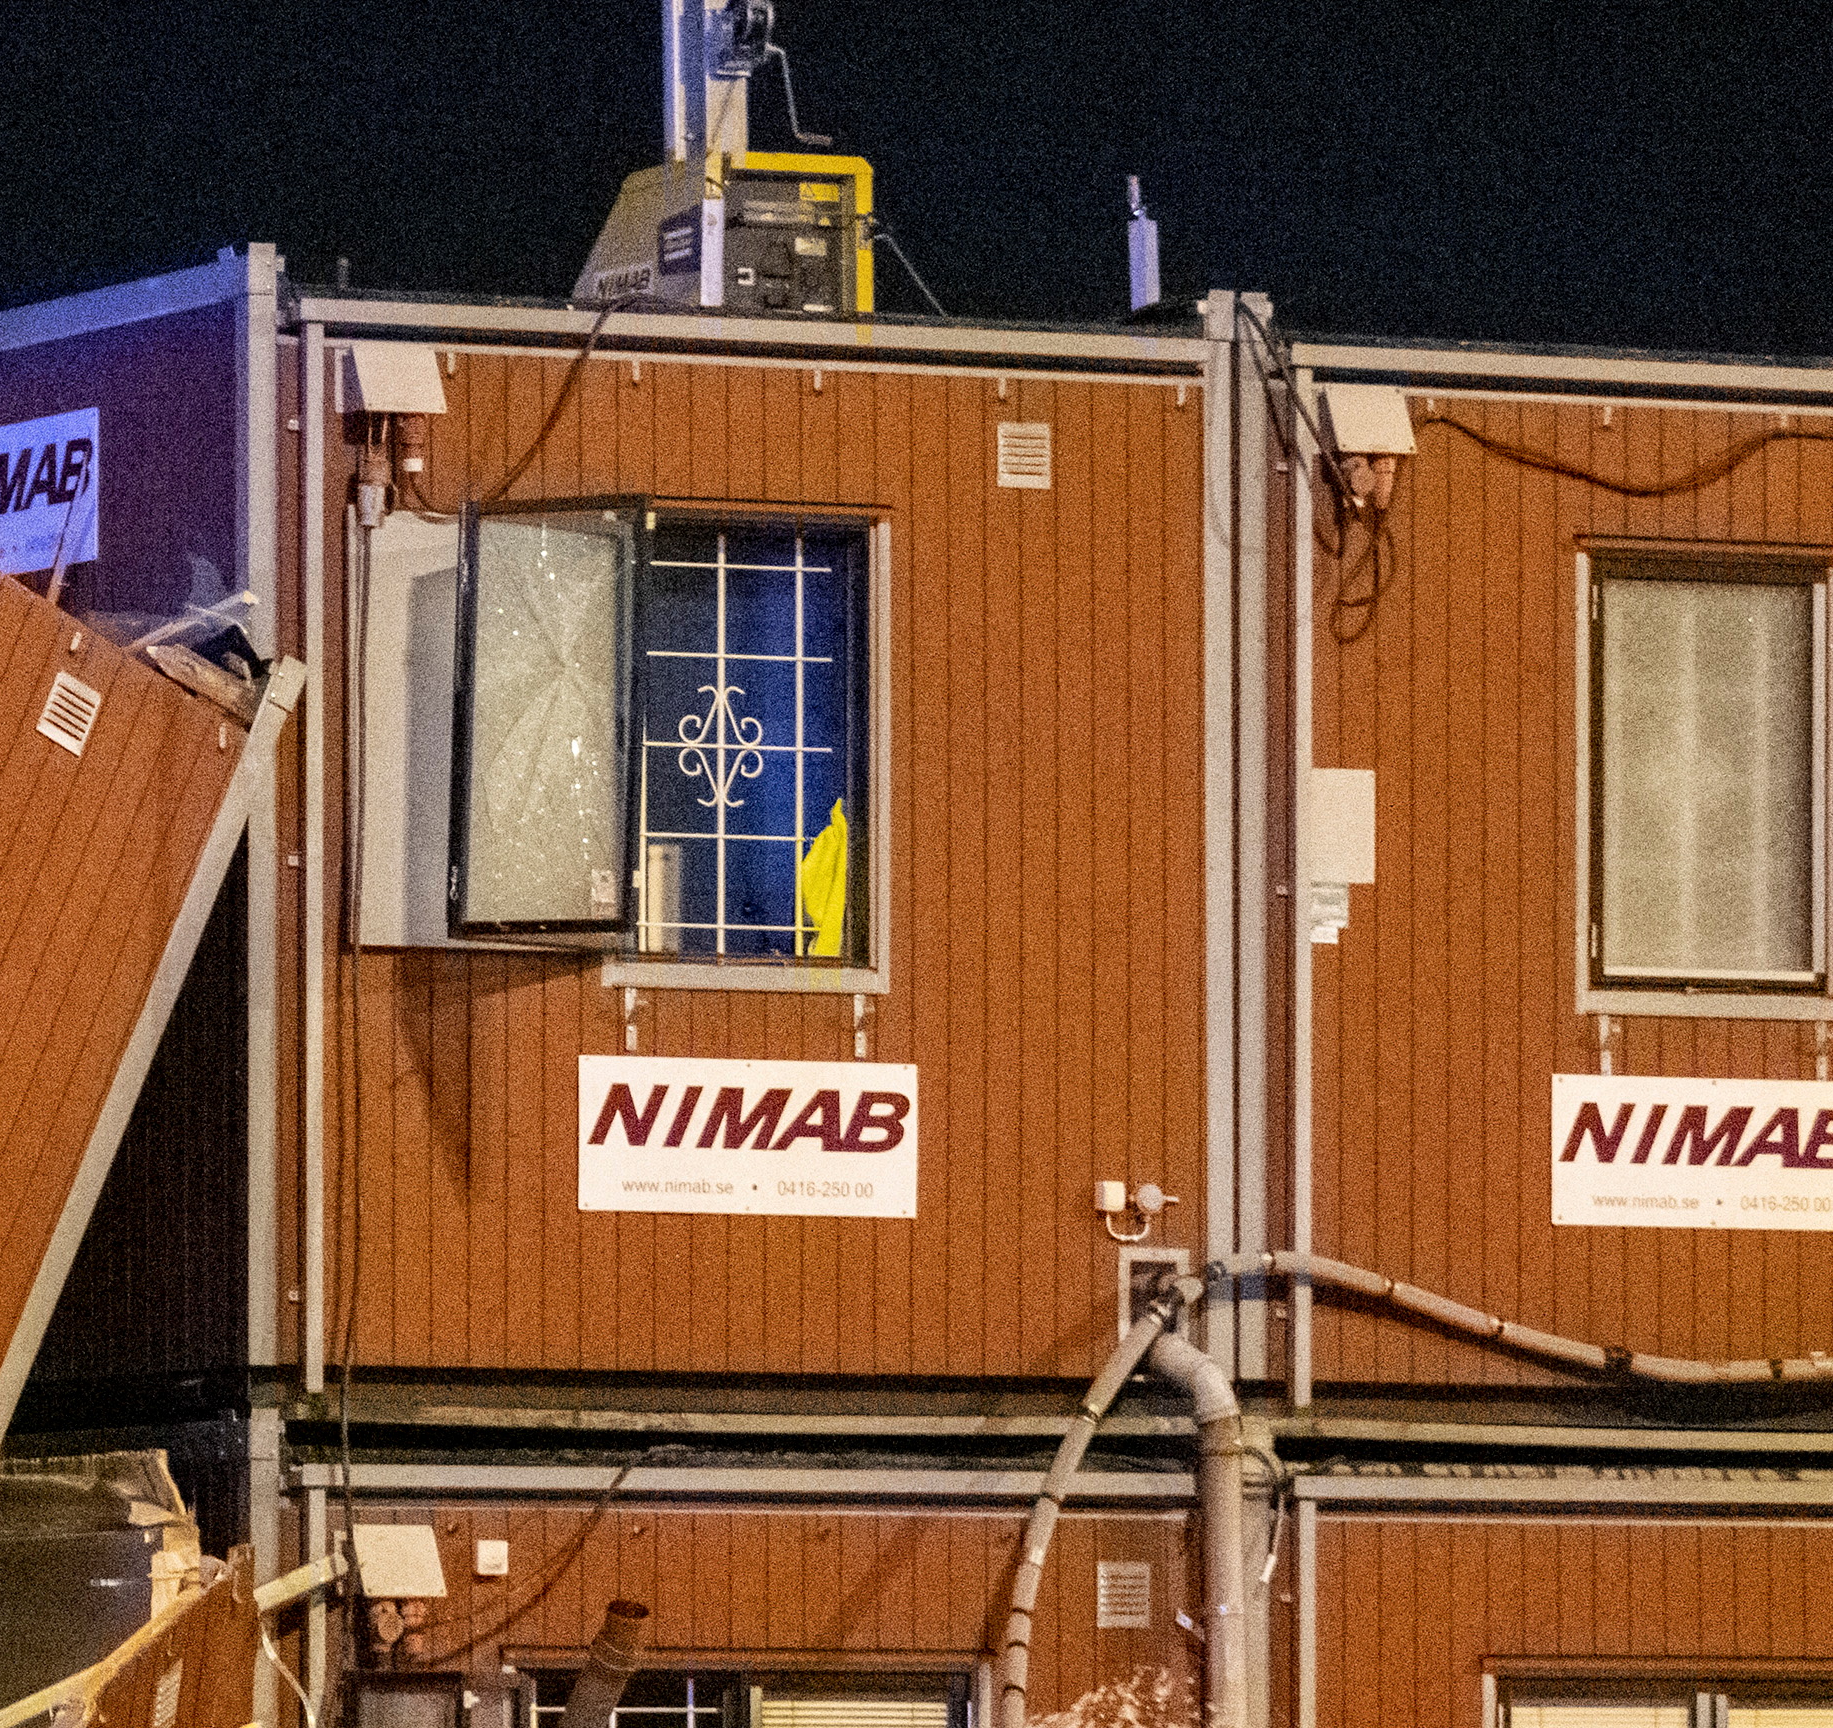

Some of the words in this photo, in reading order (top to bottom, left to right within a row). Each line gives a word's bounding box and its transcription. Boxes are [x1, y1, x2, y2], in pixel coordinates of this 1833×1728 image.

[587, 1082, 911, 1153] NIMAB
[622, 1178, 733, 1195] www.nimab.se
[777, 1180, 850, 1198] 0416-250
[855, 1183, 874, 1198] 00
[1592, 1194, 1700, 1209] www.nimab.se
[1740, 1196, 1809, 1212] 0416-250
[1814, 1199, 1831, 1212] 00
